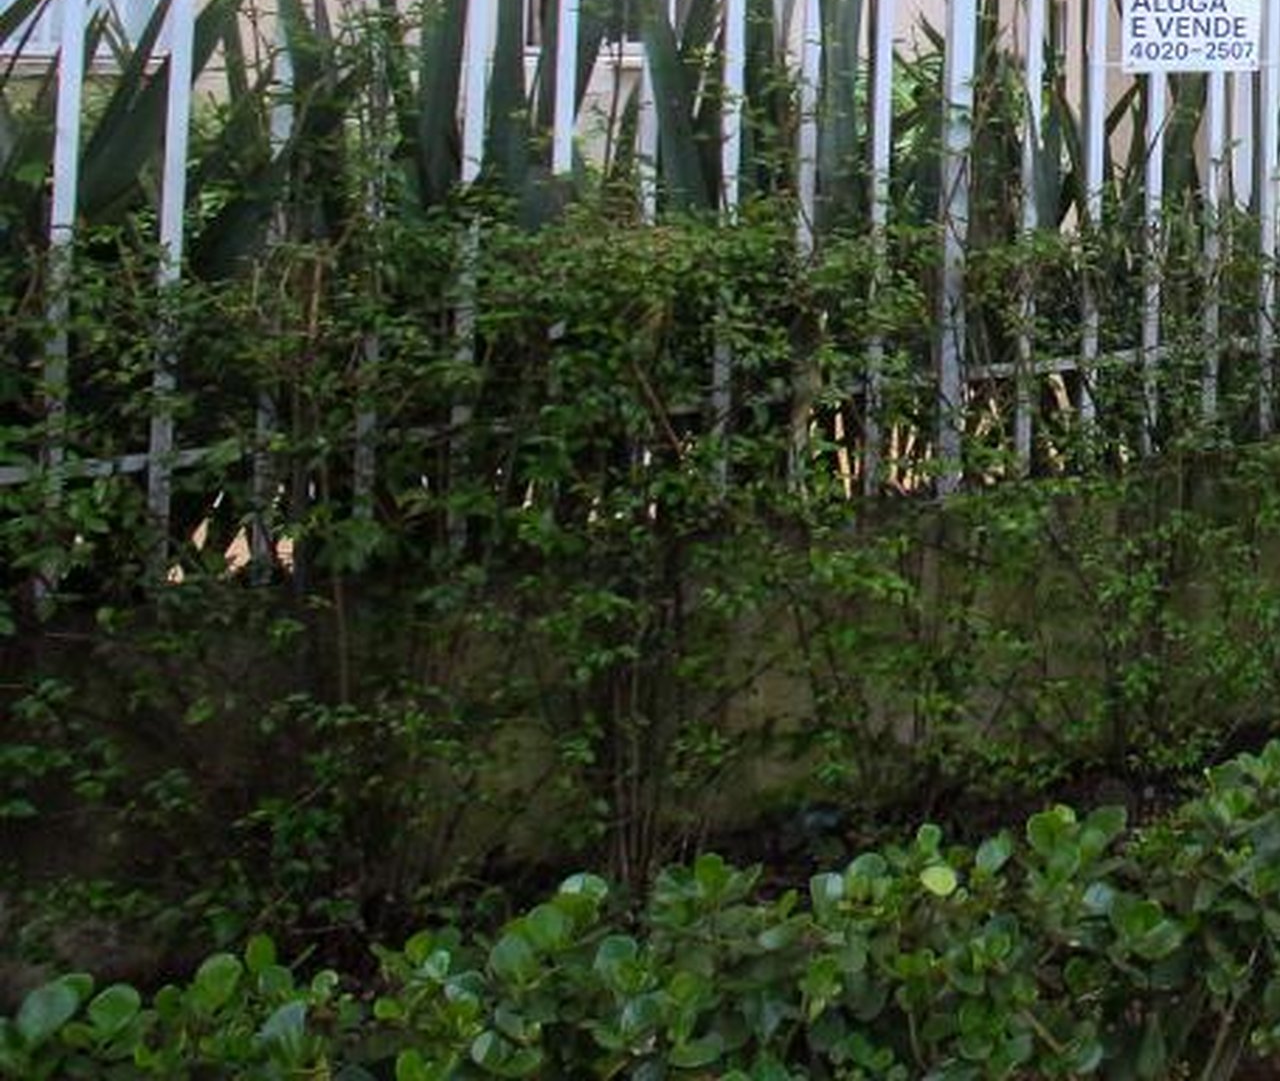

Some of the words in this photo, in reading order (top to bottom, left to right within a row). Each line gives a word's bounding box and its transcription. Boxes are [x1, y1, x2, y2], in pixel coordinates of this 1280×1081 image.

[1132, 17, 1146, 37] E
[1156, 17, 1247, 37] VENDE
[1130, 41, 1253, 59] 4020-2507
